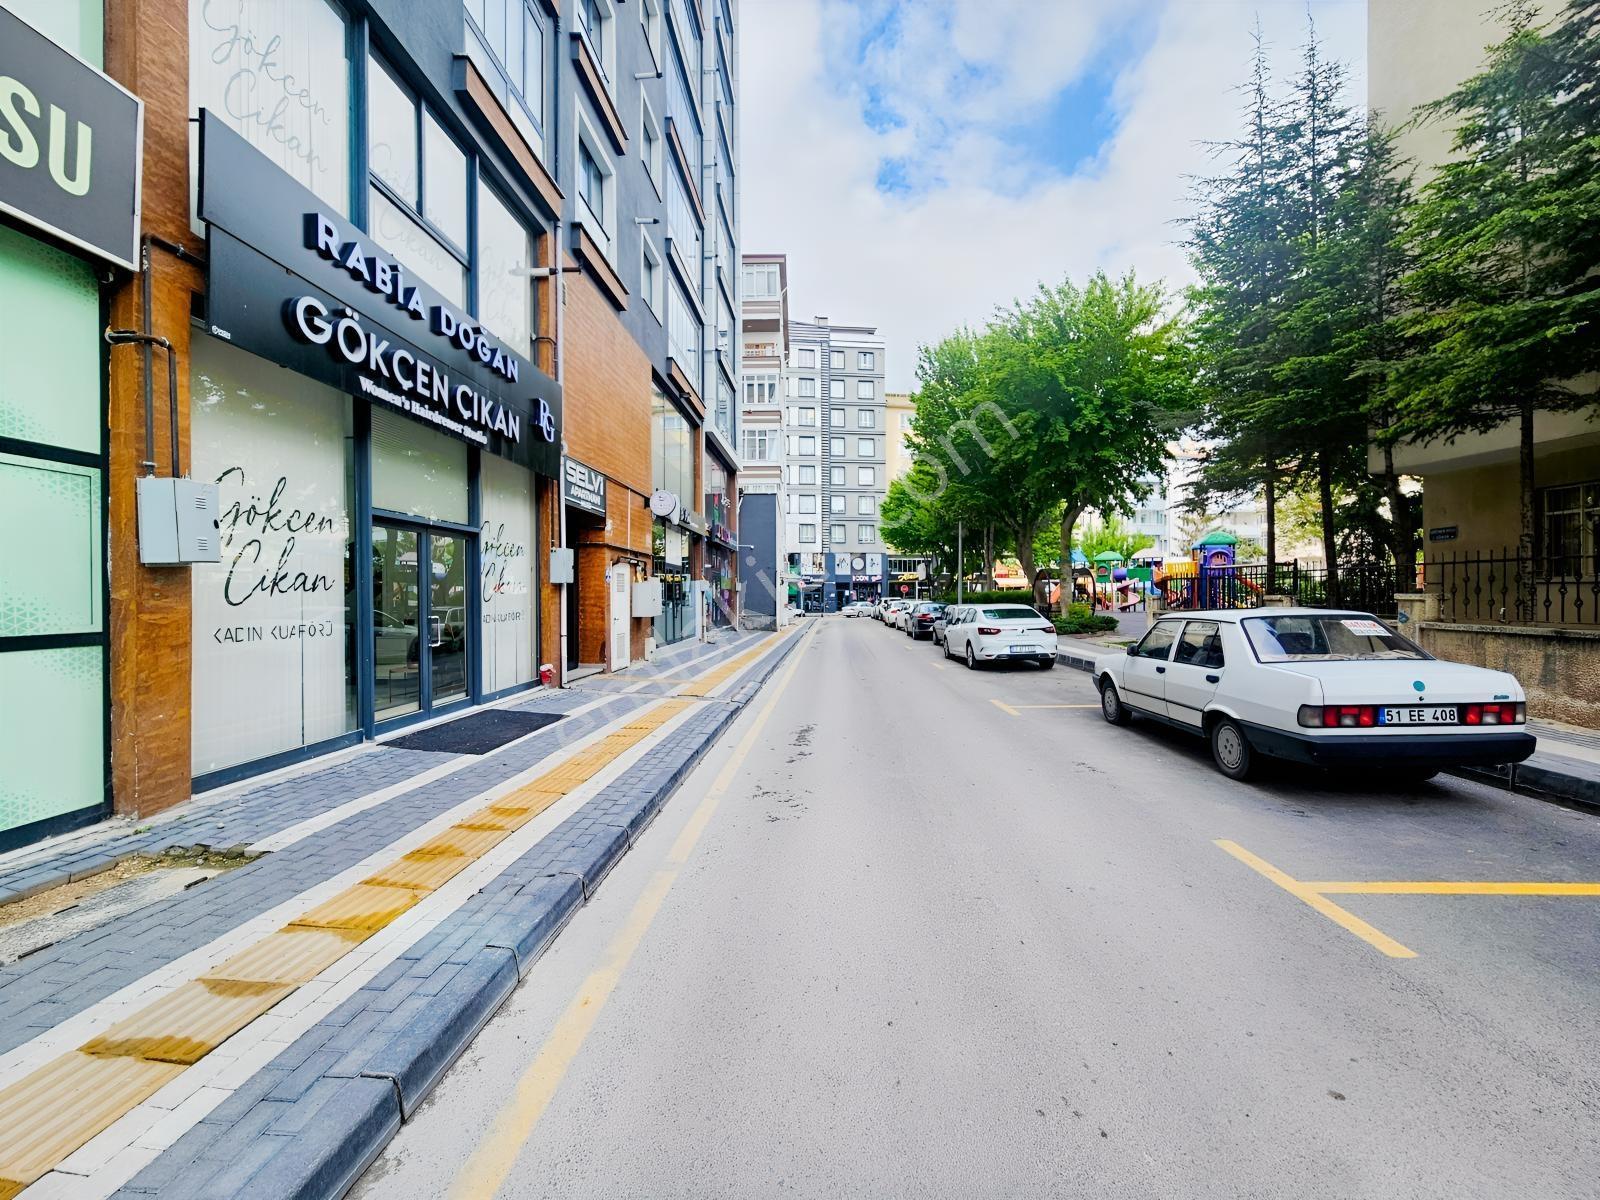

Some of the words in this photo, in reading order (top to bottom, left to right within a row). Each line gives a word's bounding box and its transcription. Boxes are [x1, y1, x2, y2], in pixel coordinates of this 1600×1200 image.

[295, 296, 449, 409] GÖKÇEN
[455, 384, 520, 443] ÇIKAN
[314, 213, 426, 320] RABİA
[438, 305, 519, 383] DOĞAN
[1386, 709, 1401, 722] 51
[1408, 709, 1425, 722] EE
[1432, 709, 1456, 722] 408
